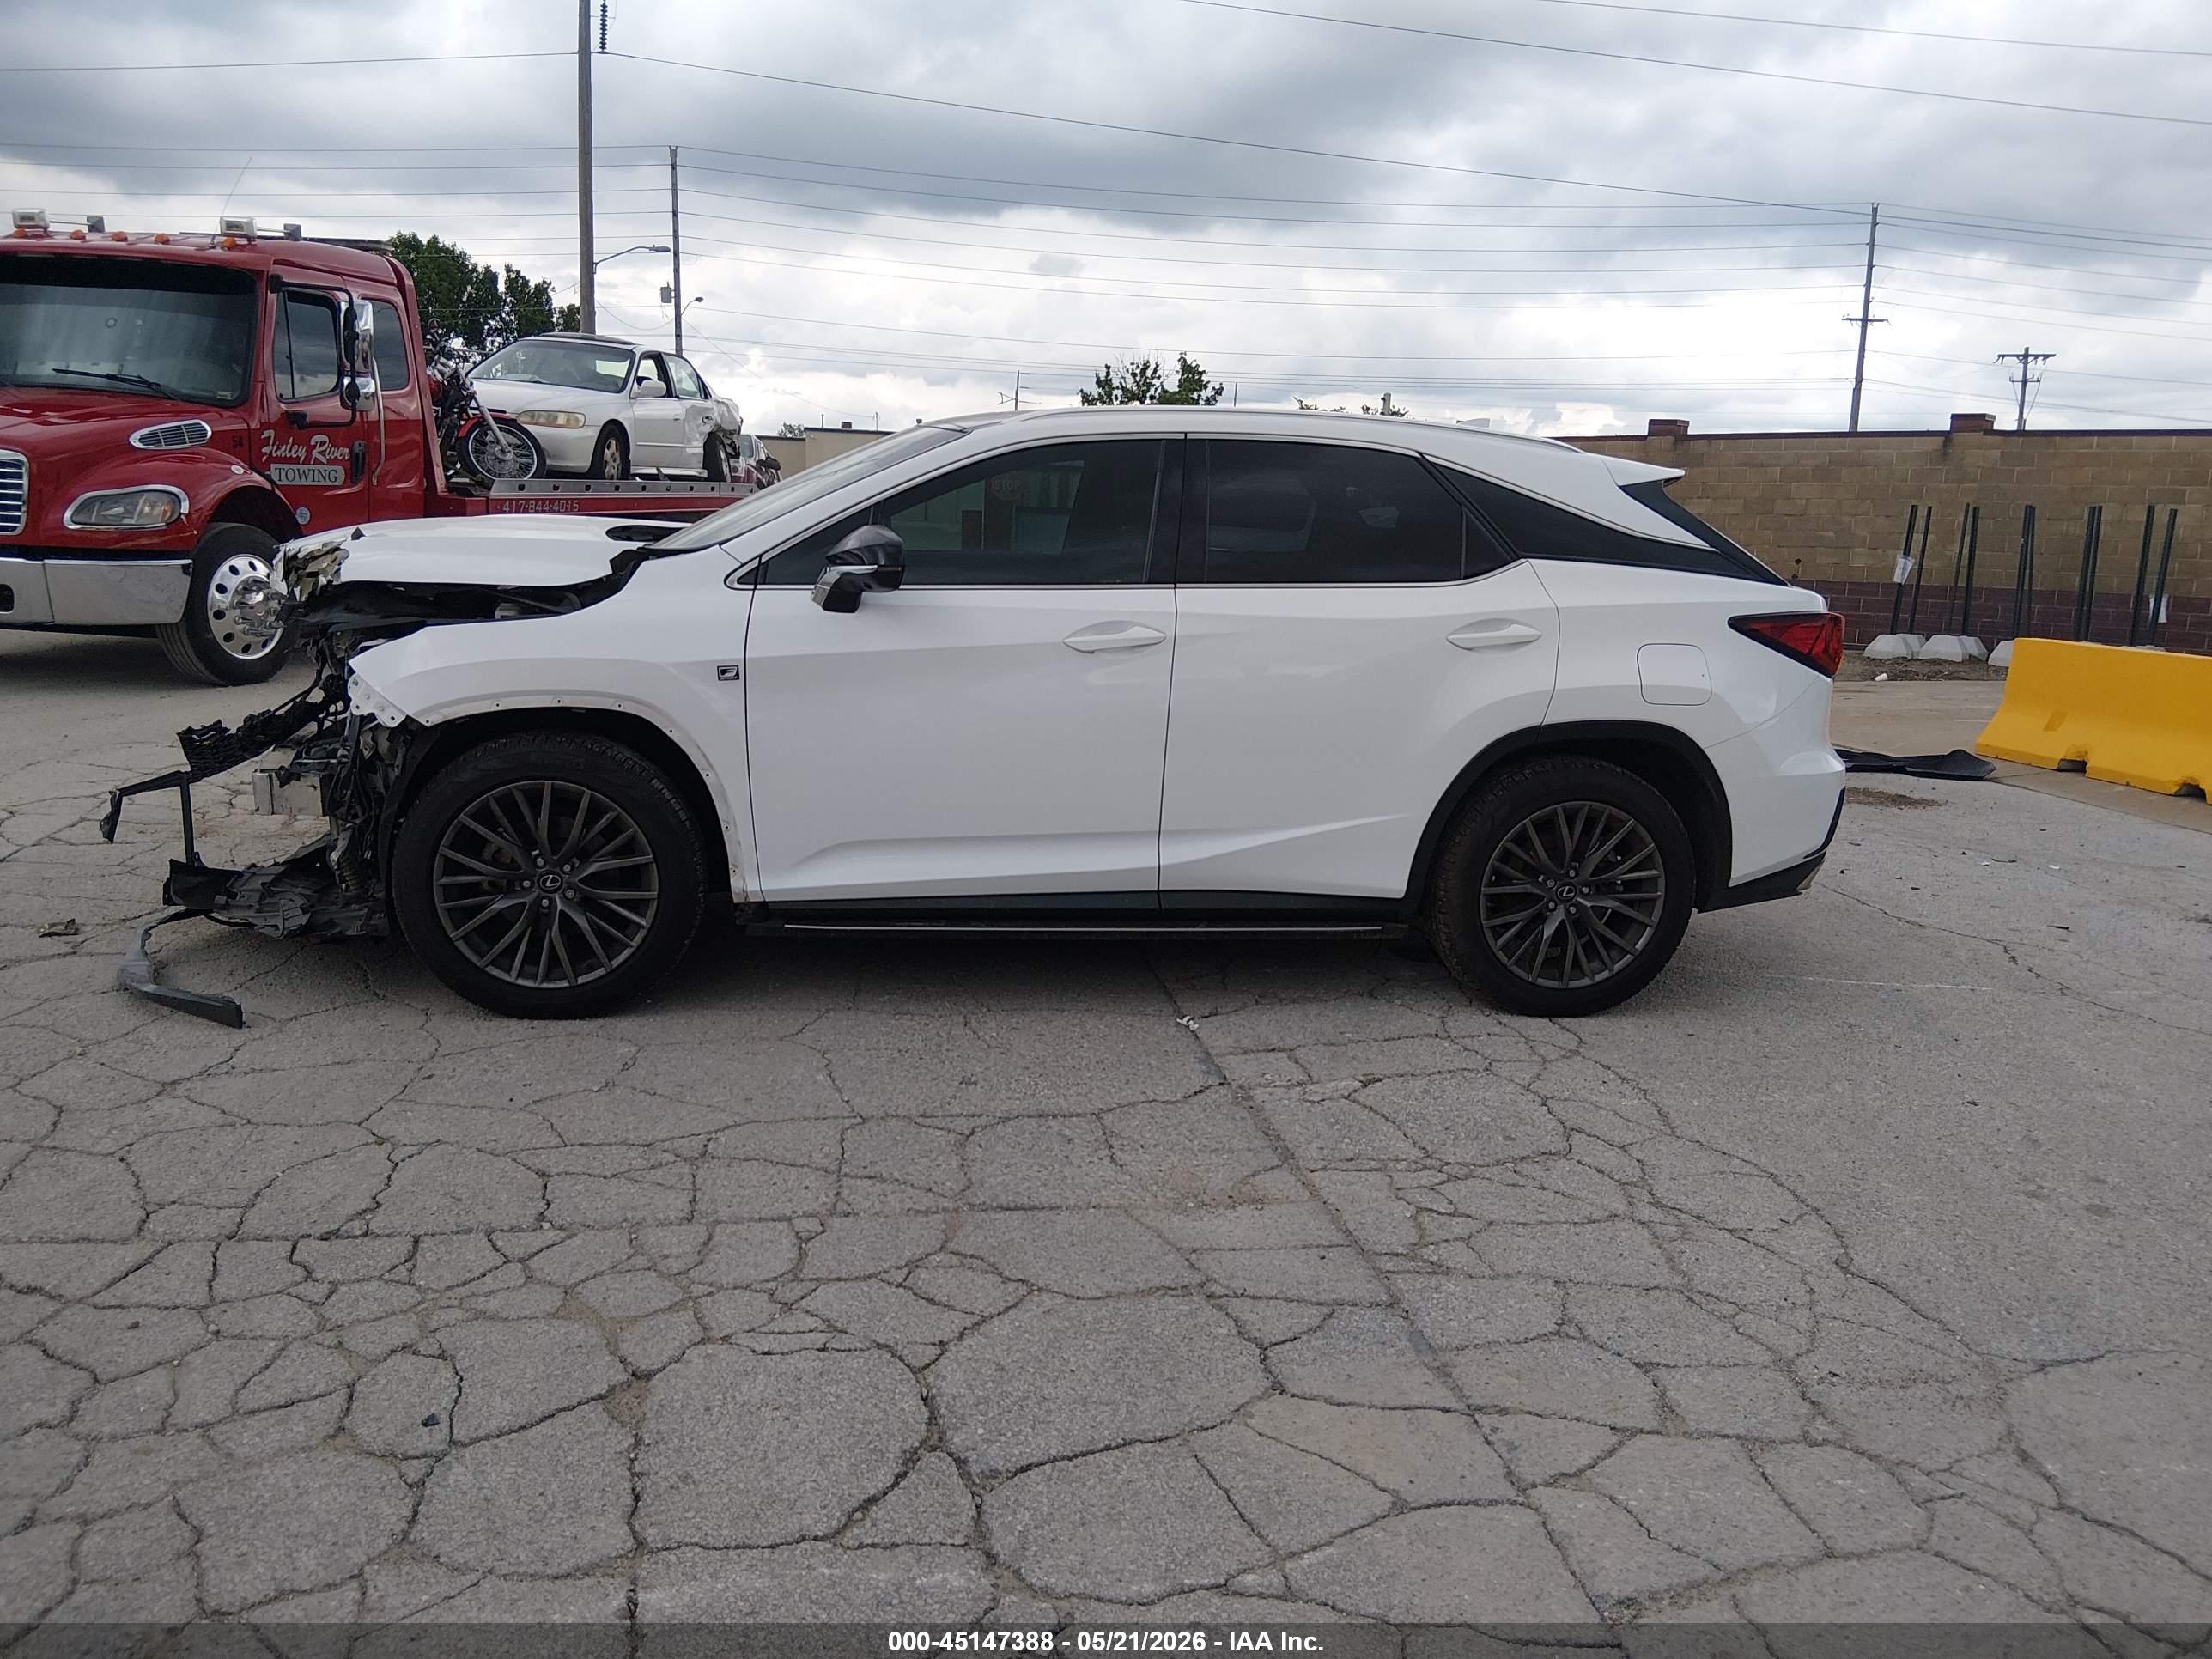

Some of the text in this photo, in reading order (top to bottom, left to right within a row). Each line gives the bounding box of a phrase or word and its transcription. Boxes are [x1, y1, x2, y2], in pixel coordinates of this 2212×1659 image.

[261, 429, 351, 465] Finley River
[275, 467, 338, 483] TOWING
[994, 479, 1020, 491] STOP
